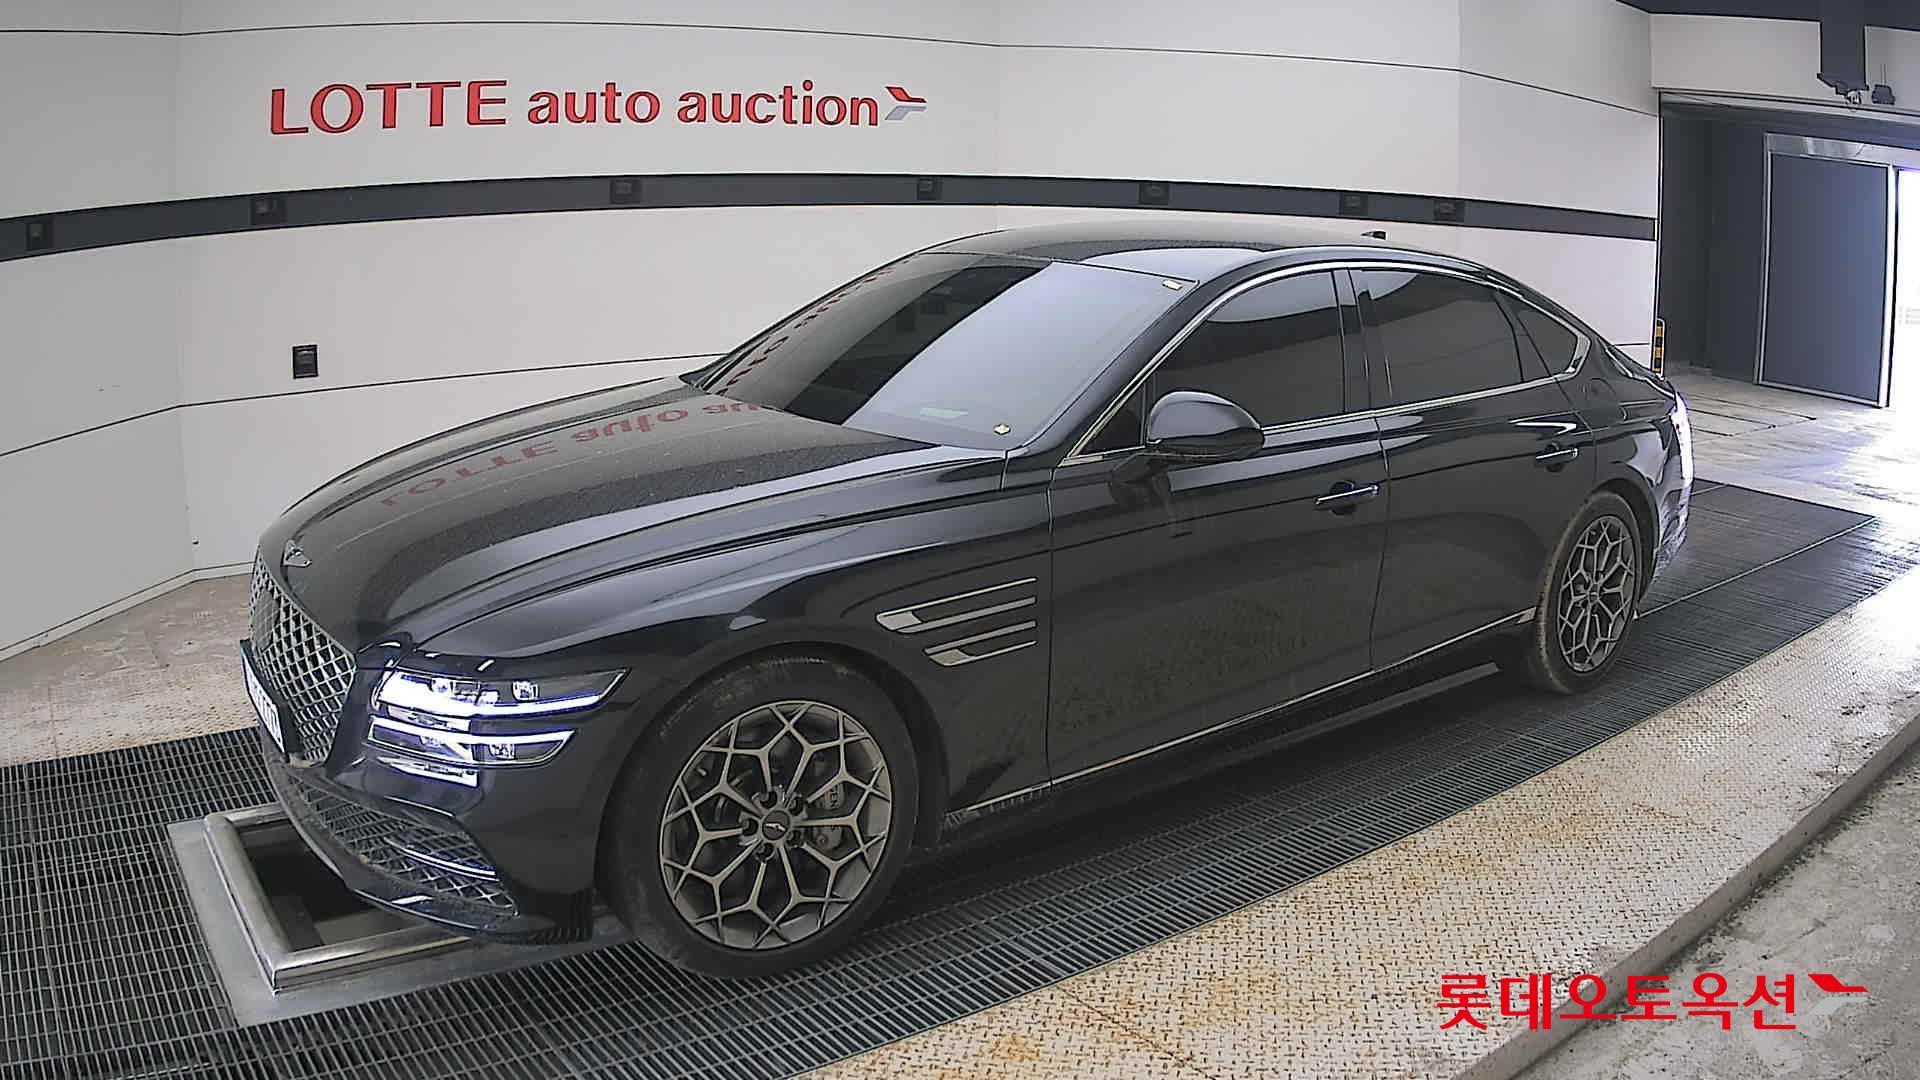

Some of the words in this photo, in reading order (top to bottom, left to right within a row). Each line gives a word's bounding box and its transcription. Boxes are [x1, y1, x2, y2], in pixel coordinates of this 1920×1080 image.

[269, 79, 508, 135] LOTTE
[527, 83, 661, 125] auto
[676, 80, 880, 128] auction
